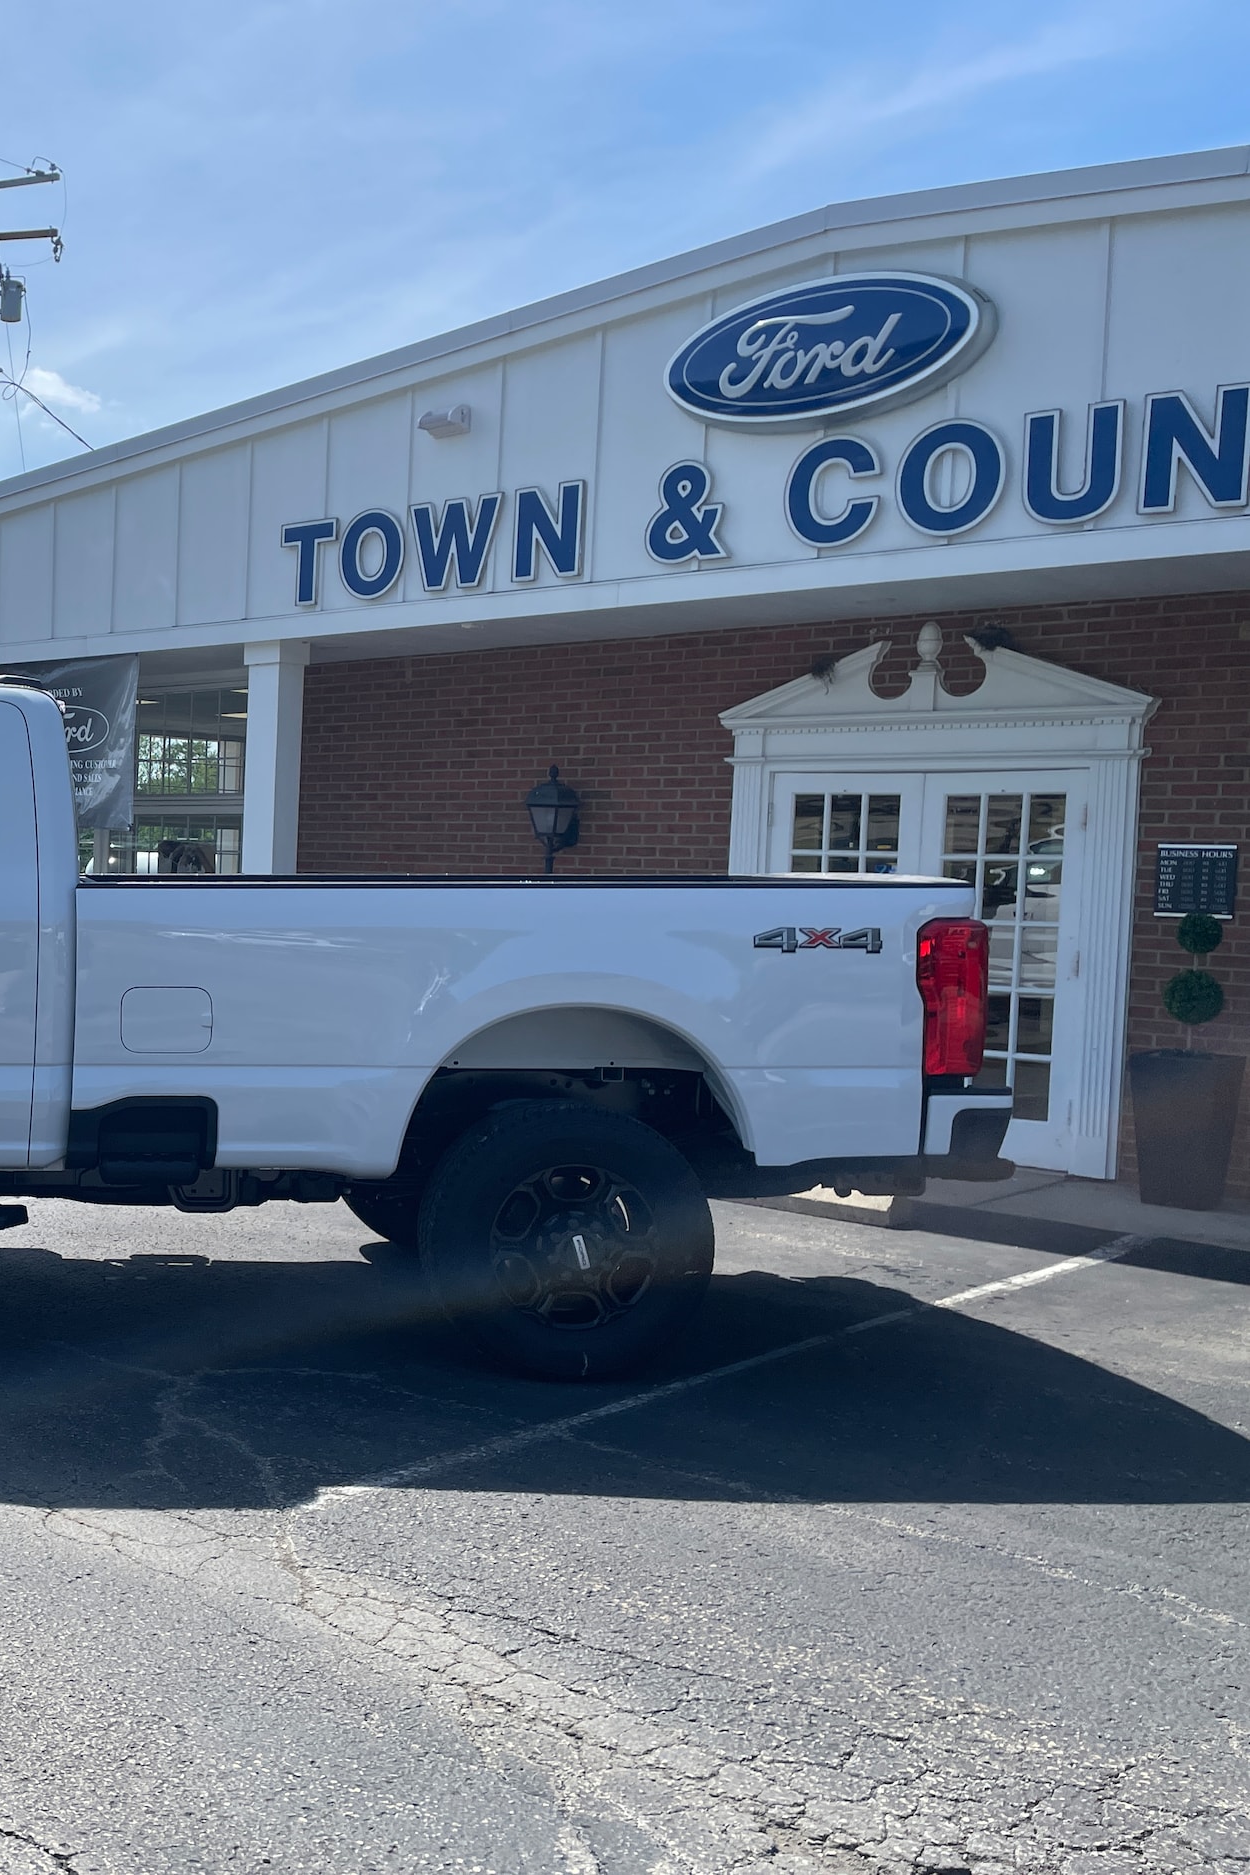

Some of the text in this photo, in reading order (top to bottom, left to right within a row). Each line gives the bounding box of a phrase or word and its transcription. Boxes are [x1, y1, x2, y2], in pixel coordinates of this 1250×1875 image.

[718, 304, 902, 399] Ford
[281, 382, 1250, 606] TOWN & COUN
[72, 688, 82, 697] BY
[83, 773, 102, 783] SALES
[1160, 850, 1234, 859] BUSINESS HOURS
